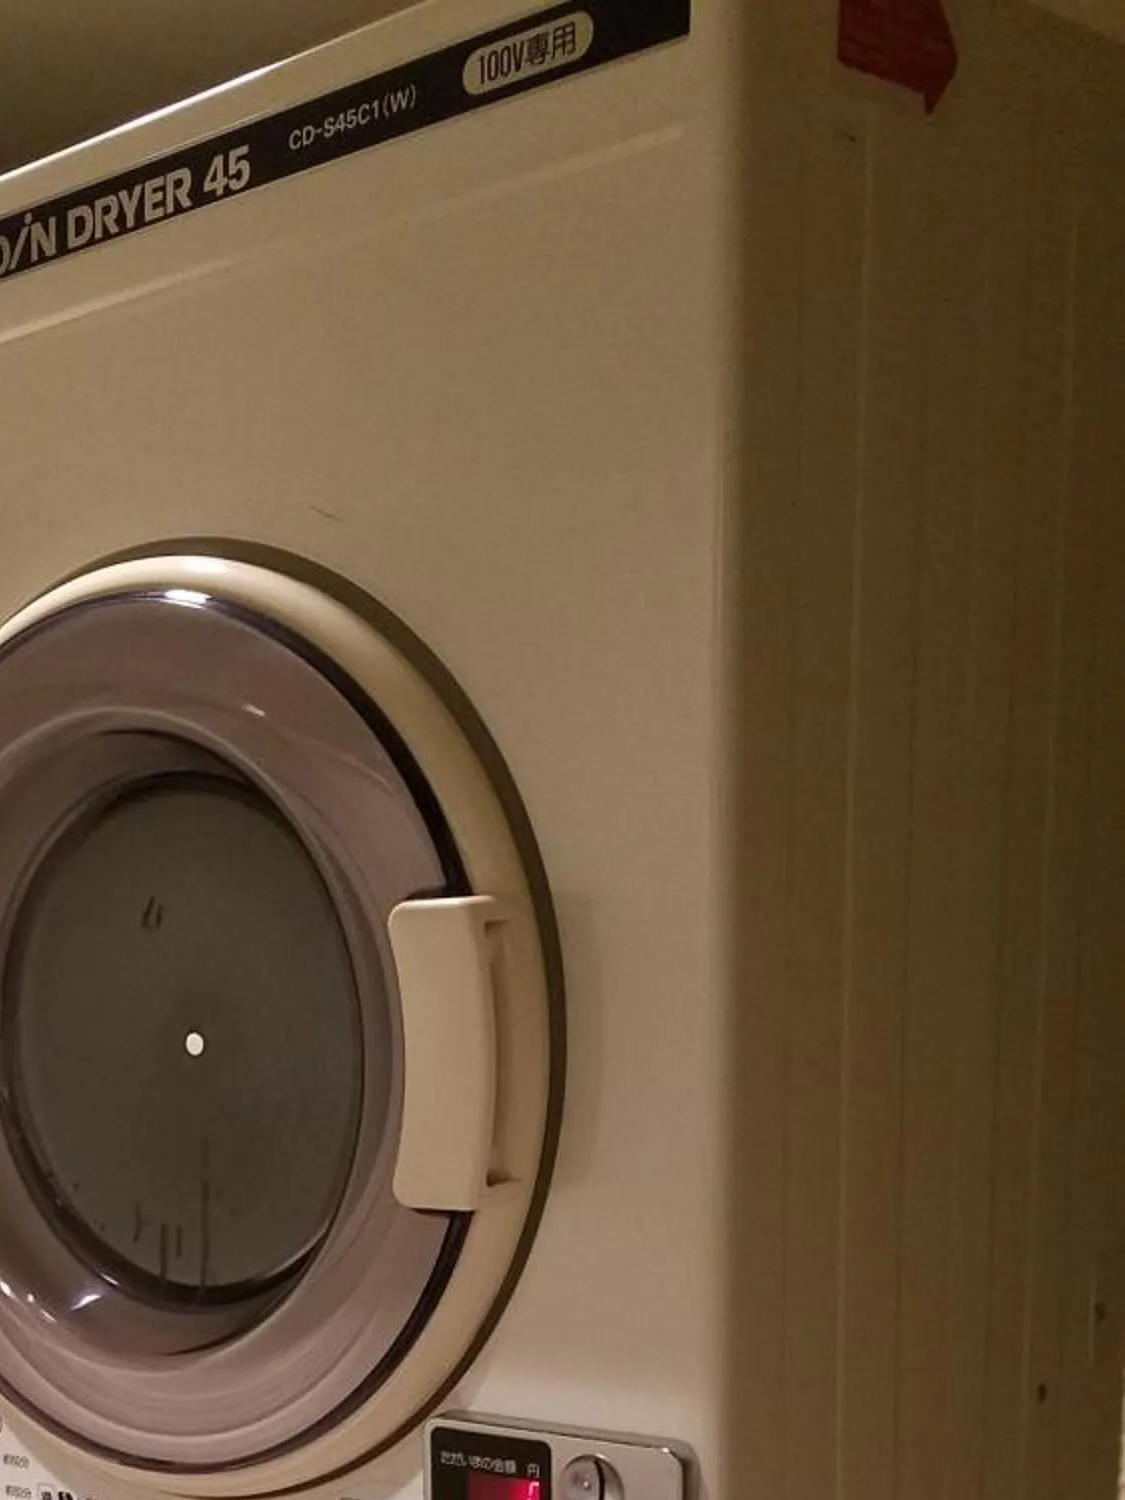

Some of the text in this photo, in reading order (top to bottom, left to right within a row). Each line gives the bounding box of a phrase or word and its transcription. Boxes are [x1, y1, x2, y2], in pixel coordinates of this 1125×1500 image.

[477, 20, 577, 85] 100V専用
[288, 84, 417, 150] CD-S45C1(W)
[66, 166, 193, 249] DRYER
[202, 144, 251, 198] 45
